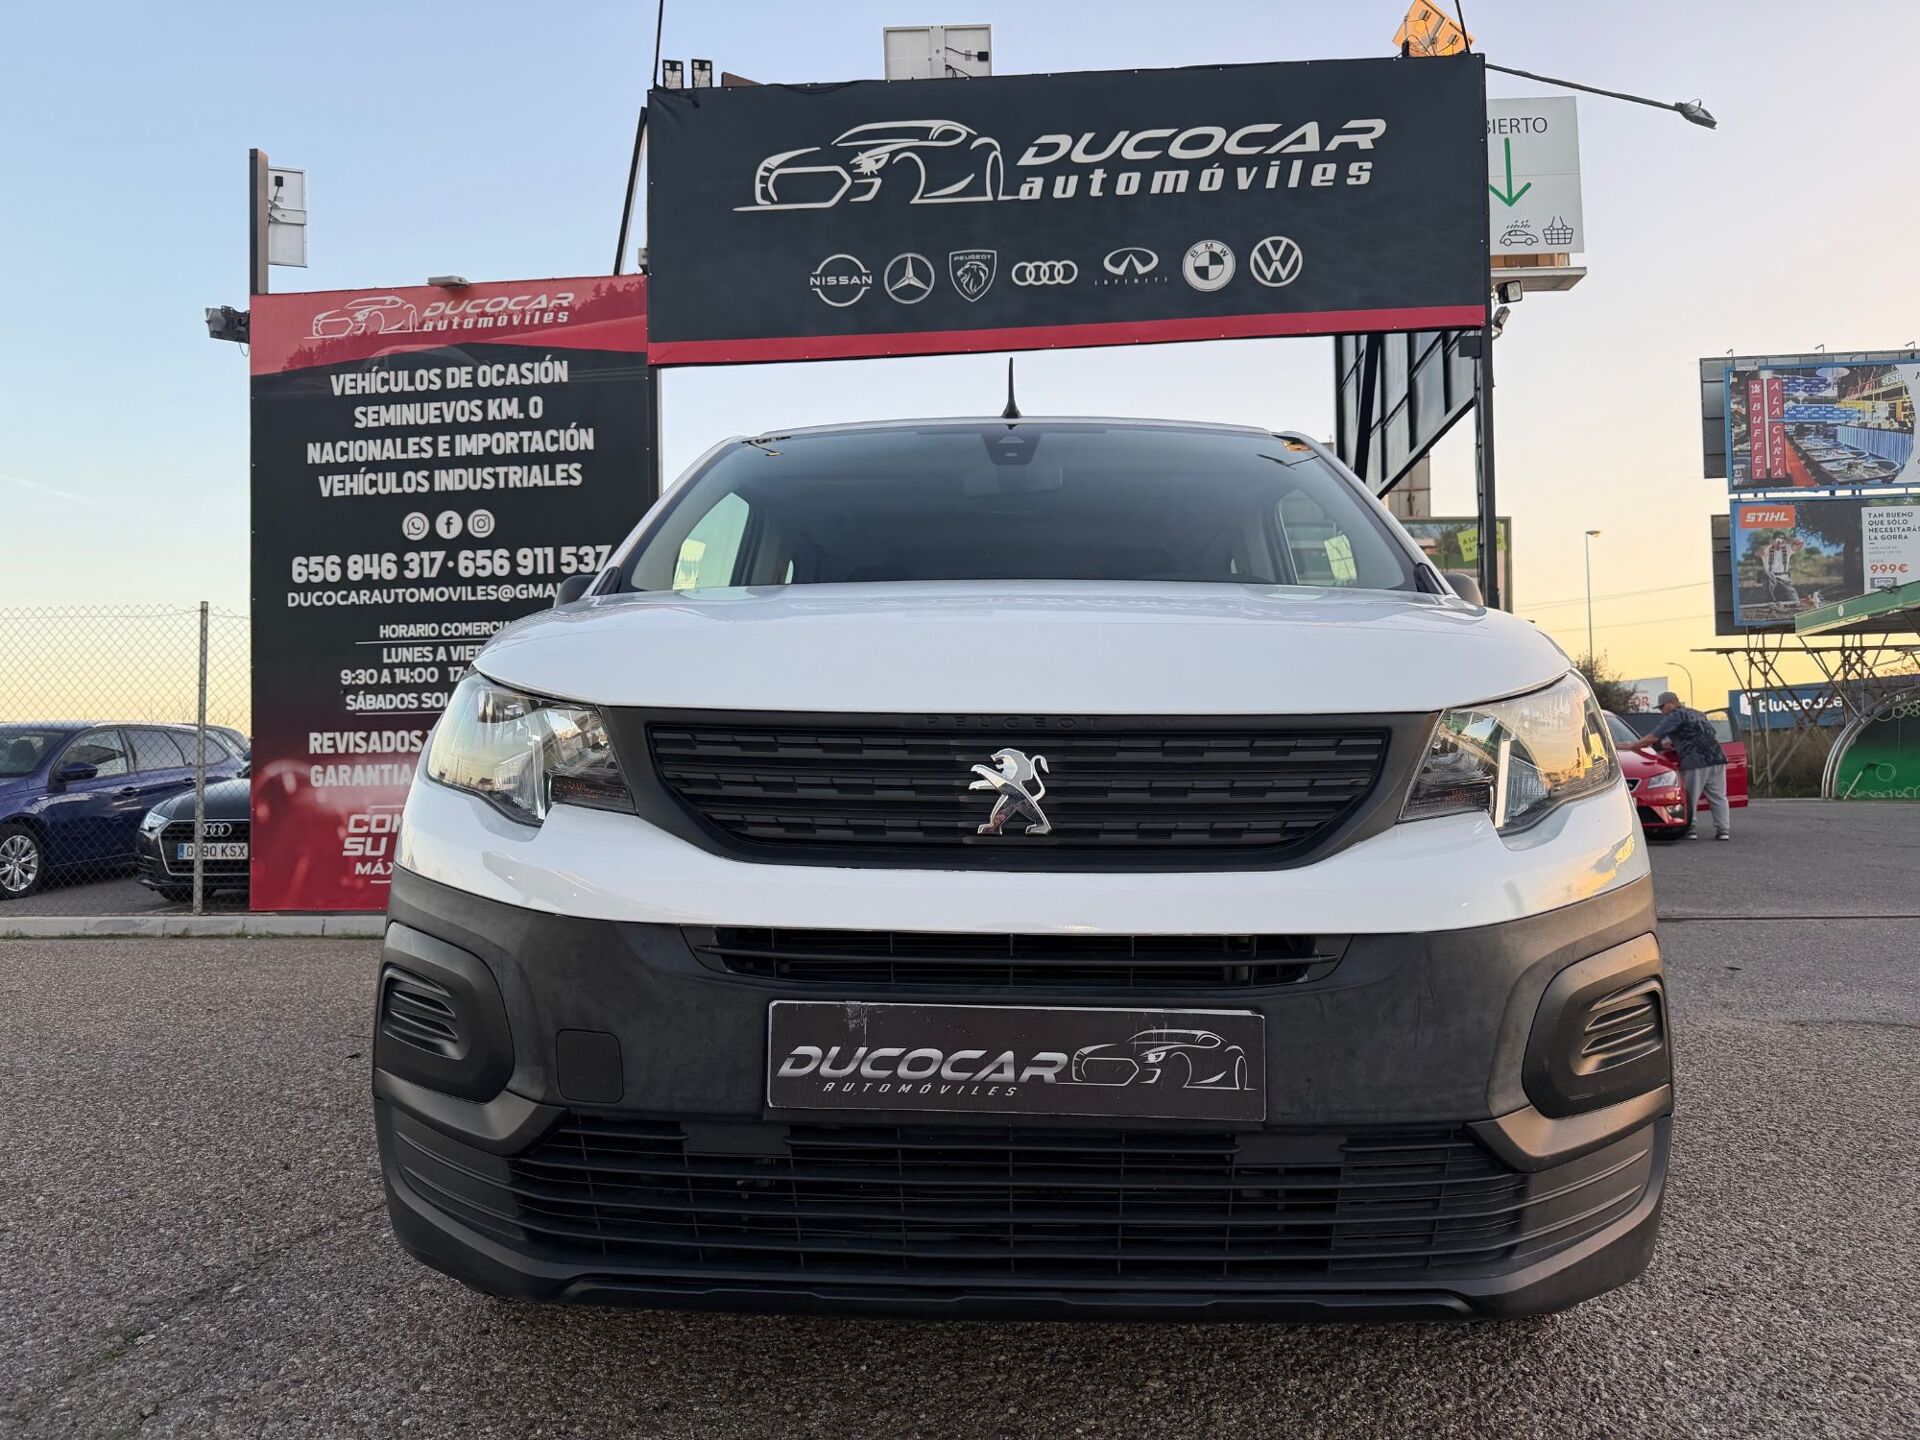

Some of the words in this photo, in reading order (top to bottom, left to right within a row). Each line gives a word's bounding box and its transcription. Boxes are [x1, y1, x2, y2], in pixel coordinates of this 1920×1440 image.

[1016, 118, 1387, 166] DUCOCAR
[1018, 158, 1373, 201] automóviles
[810, 273, 872, 287] NISSAN
[422, 292, 575, 317] DUCOCAR
[422, 311, 569, 332] automóviles
[330, 366, 442, 396] VEHÍCULOS
[445, 367, 472, 389] DE
[476, 354, 569, 387] OCASIÓN
[354, 399, 483, 429] SEMINUEVOS
[486, 397, 525, 421] KM.
[306, 436, 434, 465] NACIONALES
[437, 435, 451, 457] E
[454, 422, 595, 456] IMPORTACIÓN
[1751, 403, 1763, 477] BUFFET
[1772, 425, 1783, 476] CARTA
[318, 467, 431, 498] VEHÍCULOS
[434, 463, 583, 491] INDUSTRIALES
[1744, 512, 1790, 523] STIHL
[291, 553, 342, 584] 656
[346, 552, 398, 582] 846
[516, 547, 556, 576] 911
[560, 545, 613, 575] 537
[1870, 563, 1908, 574] 999€
[379, 623, 440, 638] HORARIO
[382, 646, 434, 663] LUNES
[436, 645, 448, 662] A
[340, 668, 378, 685] 9:30
[380, 668, 392, 684] A
[393, 666, 439, 684] 14:00
[345, 690, 419, 711] SÁBADOS
[925, 716, 1105, 730] PEUGEOT
[308, 730, 424, 754] REVISADOS
[186, 845, 217, 858] 090
[221, 845, 246, 858] KSX
[342, 836, 388, 857] SU
[776, 1045, 1069, 1084] DUCOCAR
[822, 1081, 1018, 1098] AUTOMÓVILES
